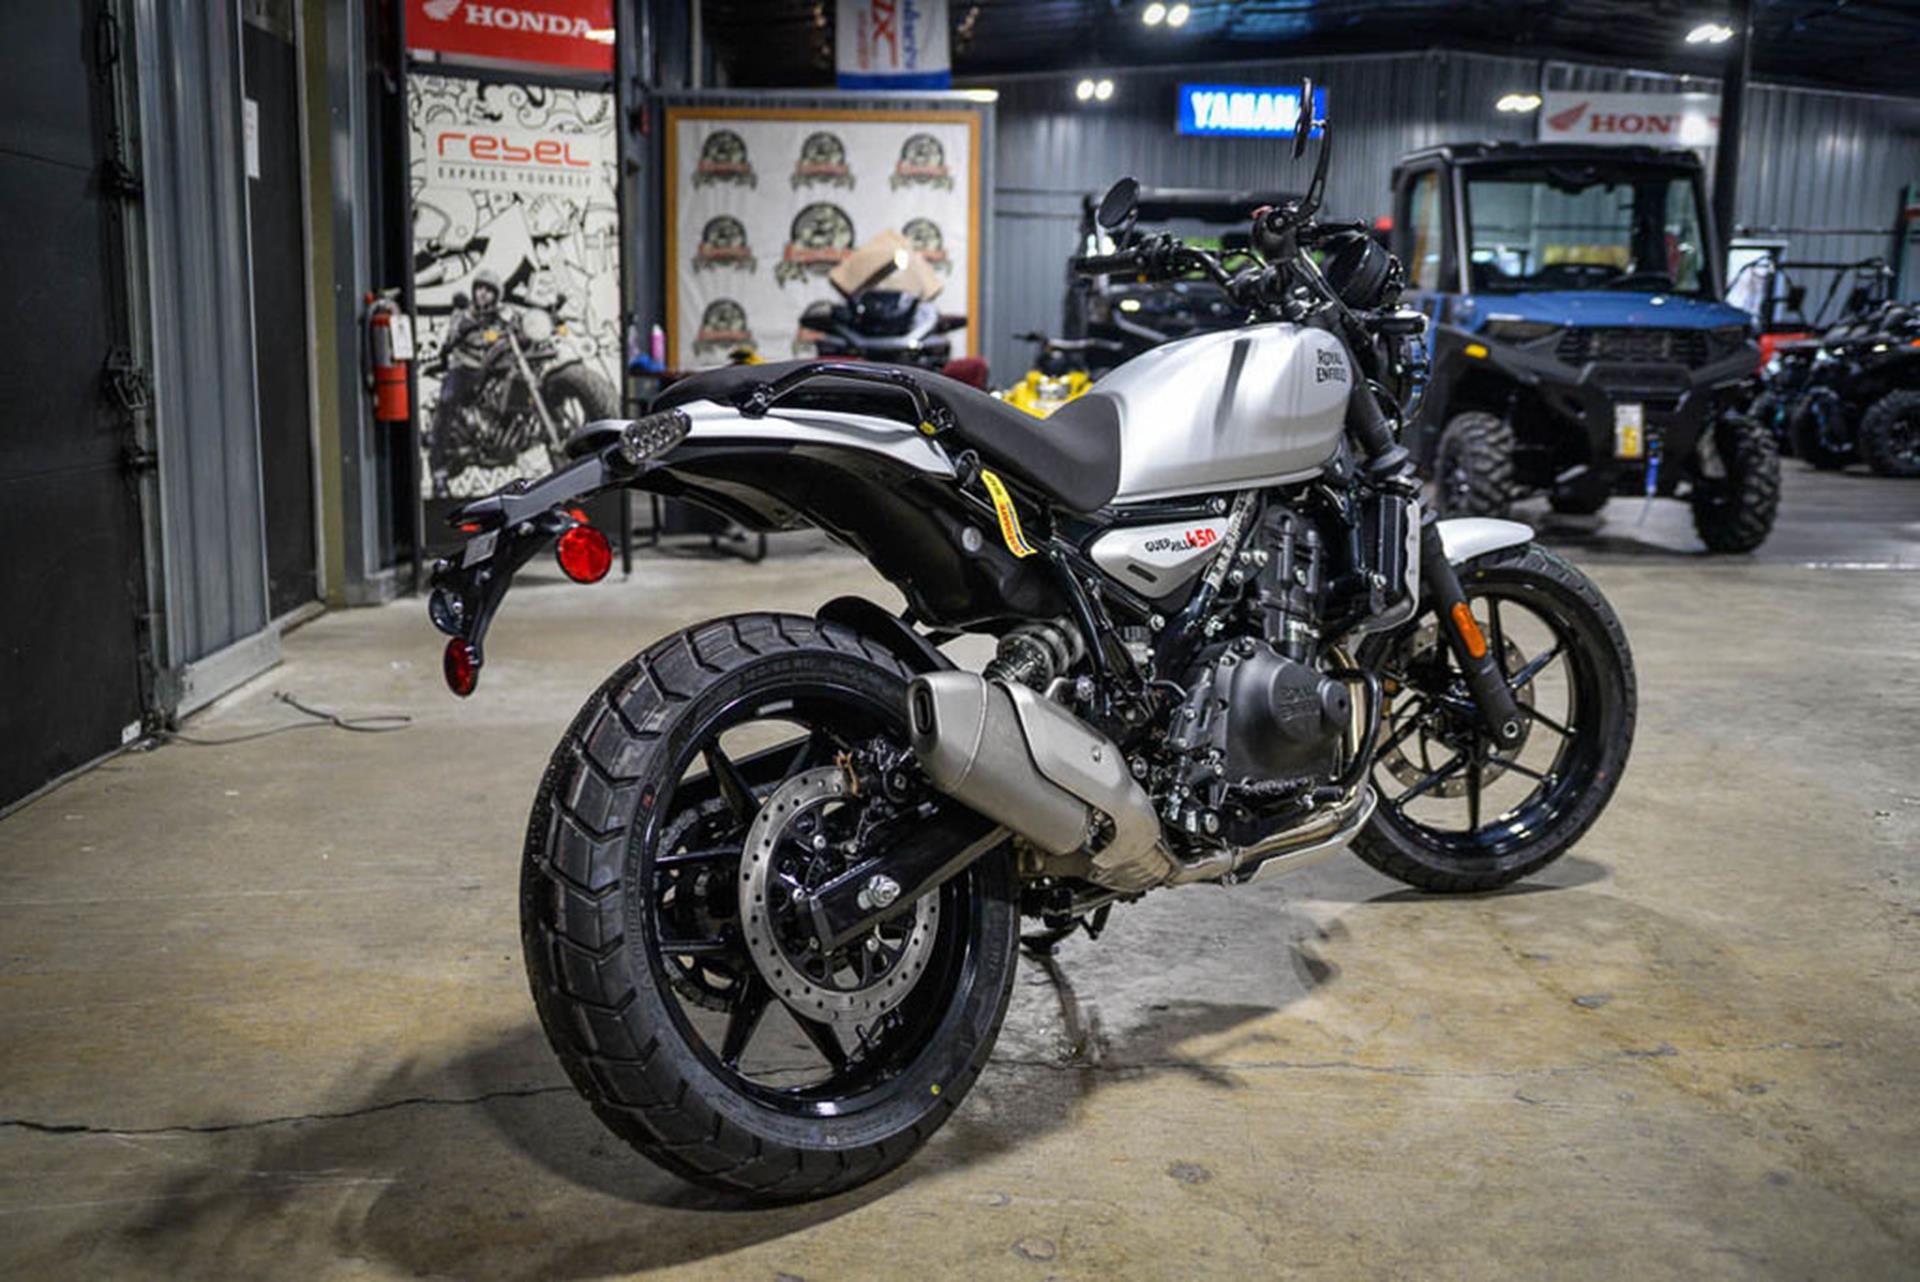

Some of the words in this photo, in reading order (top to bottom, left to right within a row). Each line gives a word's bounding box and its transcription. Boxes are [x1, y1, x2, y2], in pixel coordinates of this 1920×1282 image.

[464, 4, 592, 37] HONDA
[1190, 91, 1315, 131] YAMAH
[1589, 112, 1721, 135] HON
[437, 166, 508, 182] EXPRESS
[517, 169, 592, 187] YOURSELF
